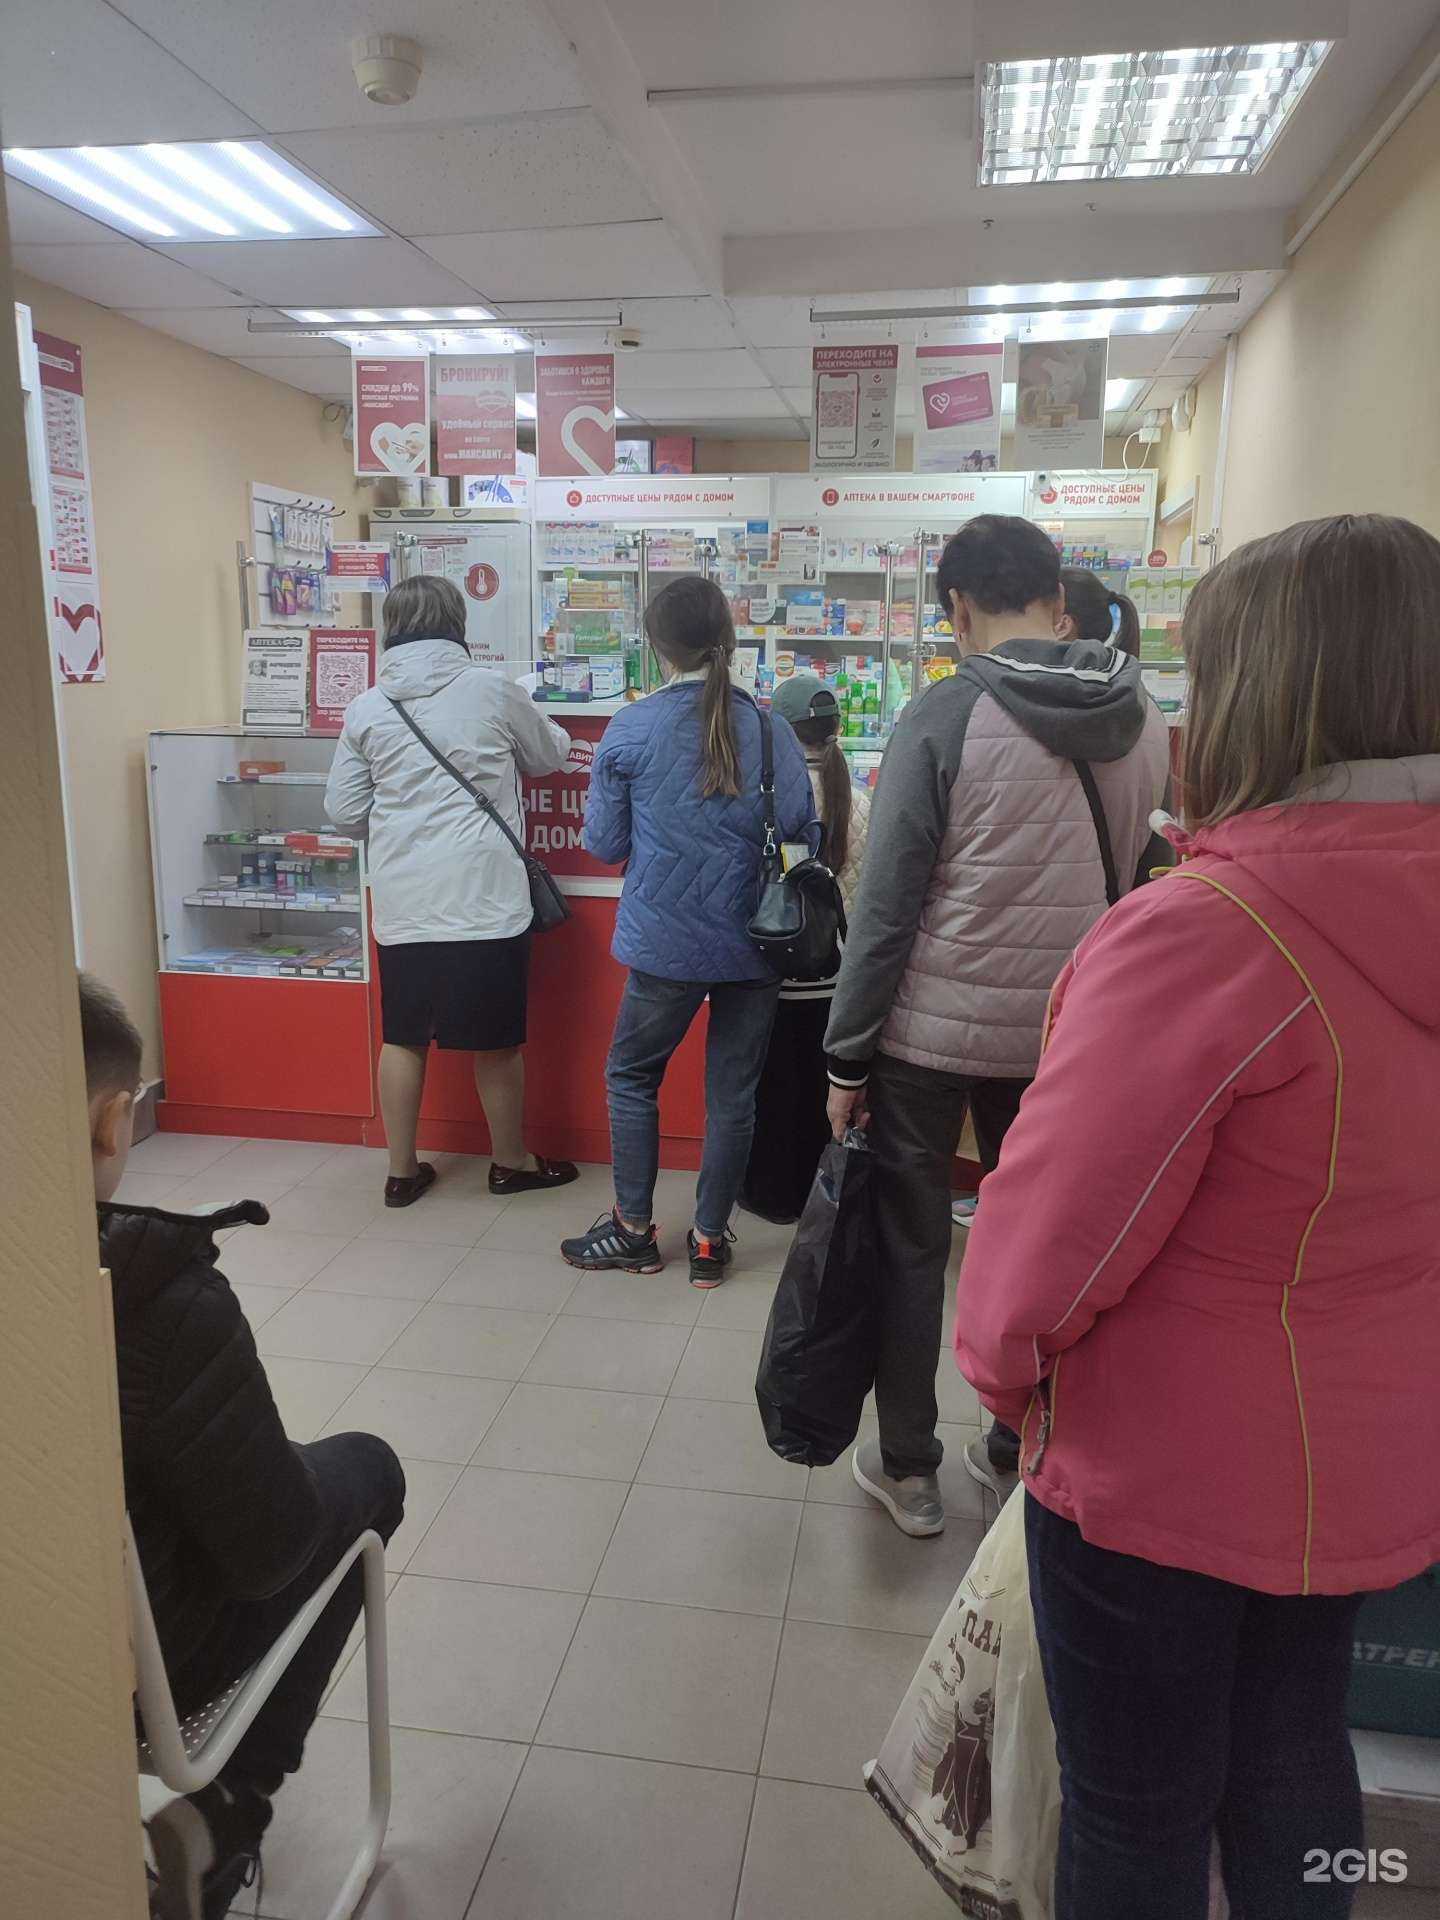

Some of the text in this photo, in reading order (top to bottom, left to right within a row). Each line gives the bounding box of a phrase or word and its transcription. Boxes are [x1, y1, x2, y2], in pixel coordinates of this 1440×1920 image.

[816, 349, 894, 361] ПЕРЕХОДИТЕ НА
[1061, 484, 1145, 494] ДОСТУПНЫЕ ЦЕНЫ
[585, 493, 734, 503] ДОСТУПНЫЕ ЦЕНЫ РЯДОМ С ДОМОМ
[843, 492, 975, 502] АПТЕКА В ВАШЕМ СМАРТФОНЕ
[1064, 495, 1140, 505] РЯДОМ С ДОМОМ
[474, 652, 505, 662] СТРОГИЙ
[569, 750, 593, 763] АВИТ
[522, 788, 553, 812] ЫЕ
[531, 825, 586, 853] ДОМ
